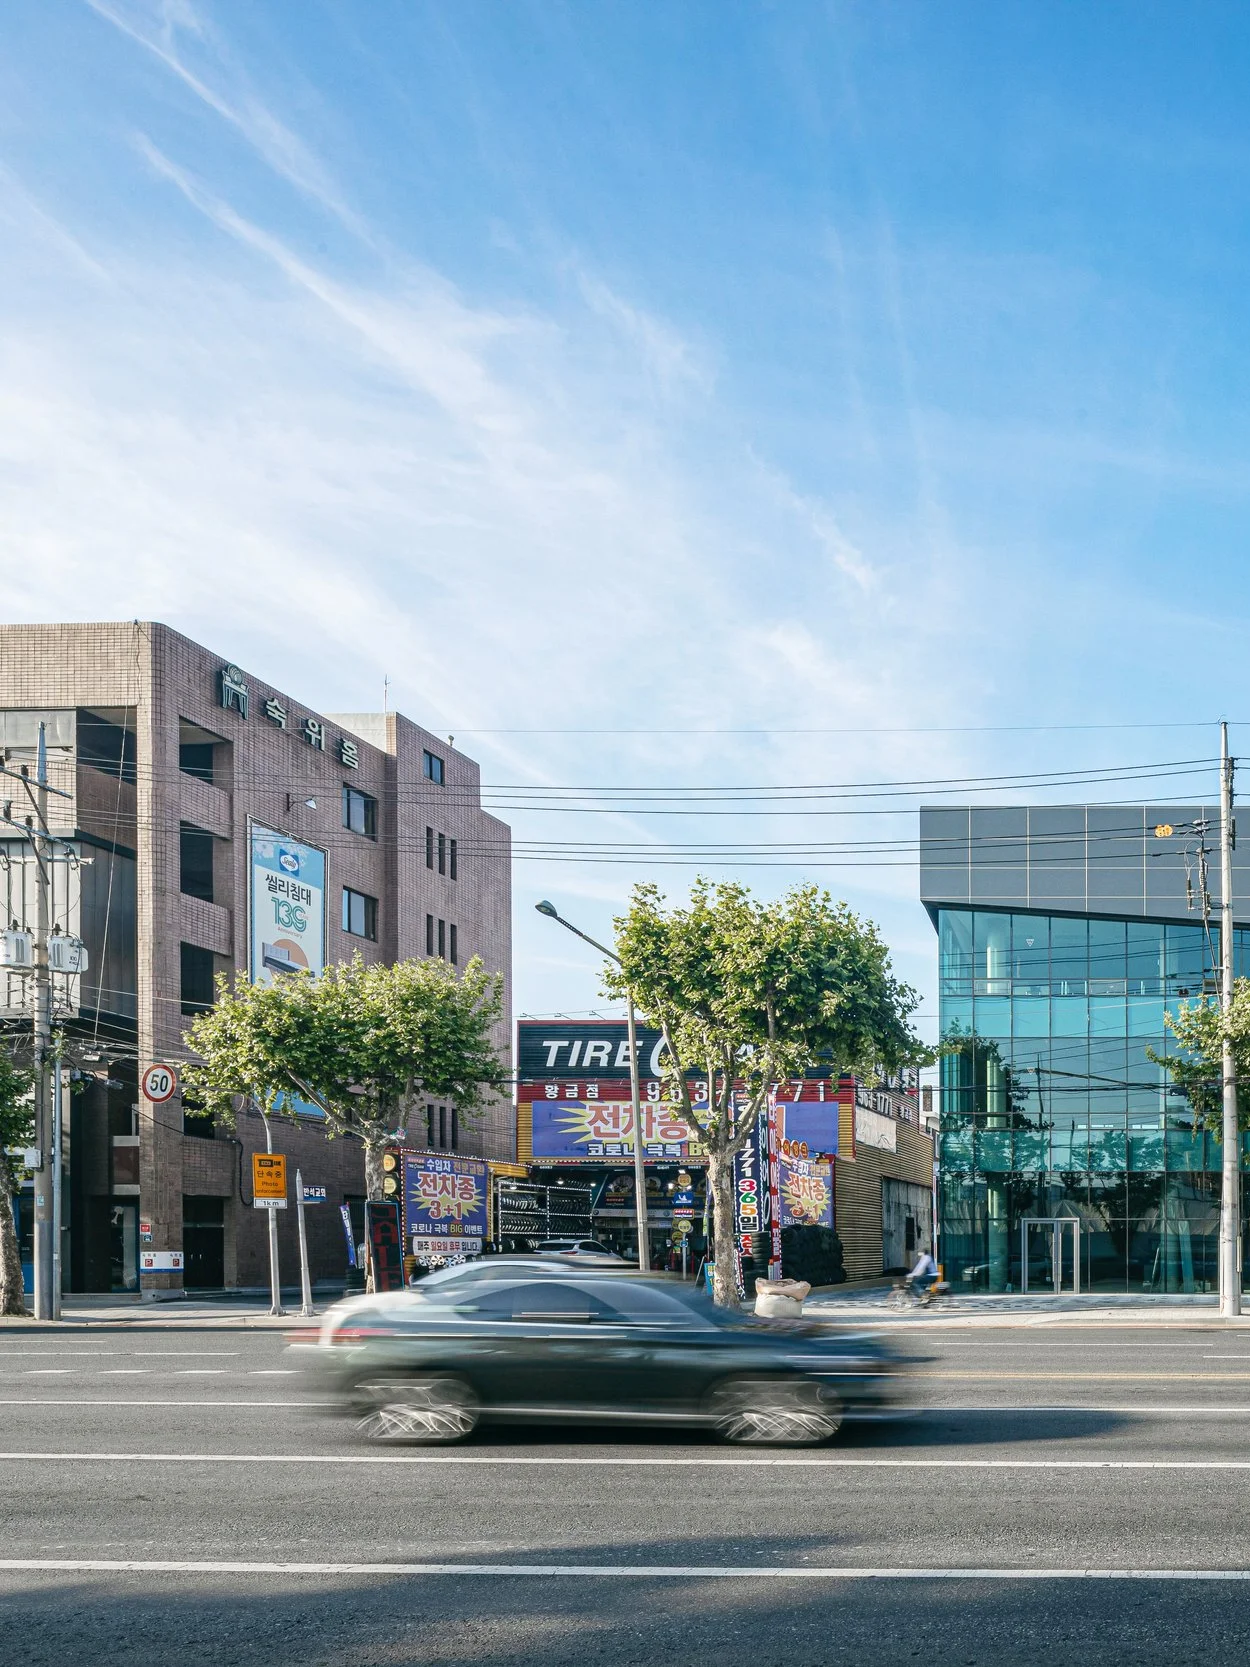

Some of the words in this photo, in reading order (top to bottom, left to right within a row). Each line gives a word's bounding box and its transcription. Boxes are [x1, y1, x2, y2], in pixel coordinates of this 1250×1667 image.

[265, 698, 360, 770] 숙위홈
[265, 873, 312, 907] 씰리침대
[542, 1040, 643, 1067] TIRE
[150, 1074, 169, 1092] 50
[544, 1084, 599, 1099] 황금점
[586, 1104, 689, 1141] 전차종
[646, 1143, 682, 1157] 극복
[256, 1170, 282, 1179] 단속중
[427, 1159, 451, 1172] 수입차
[418, 1172, 476, 1202] 전차종
[788, 1171, 825, 1201] 전차종
[429, 1200, 463, 1219] 3+1
[411, 1223, 432, 1234] 코로나
[434, 1224, 448, 1234] 극복
[450, 1224, 463, 1234] BIG
[464, 1225, 483, 1234] 이벤트
[430, 1241, 448, 1252] 일요일
